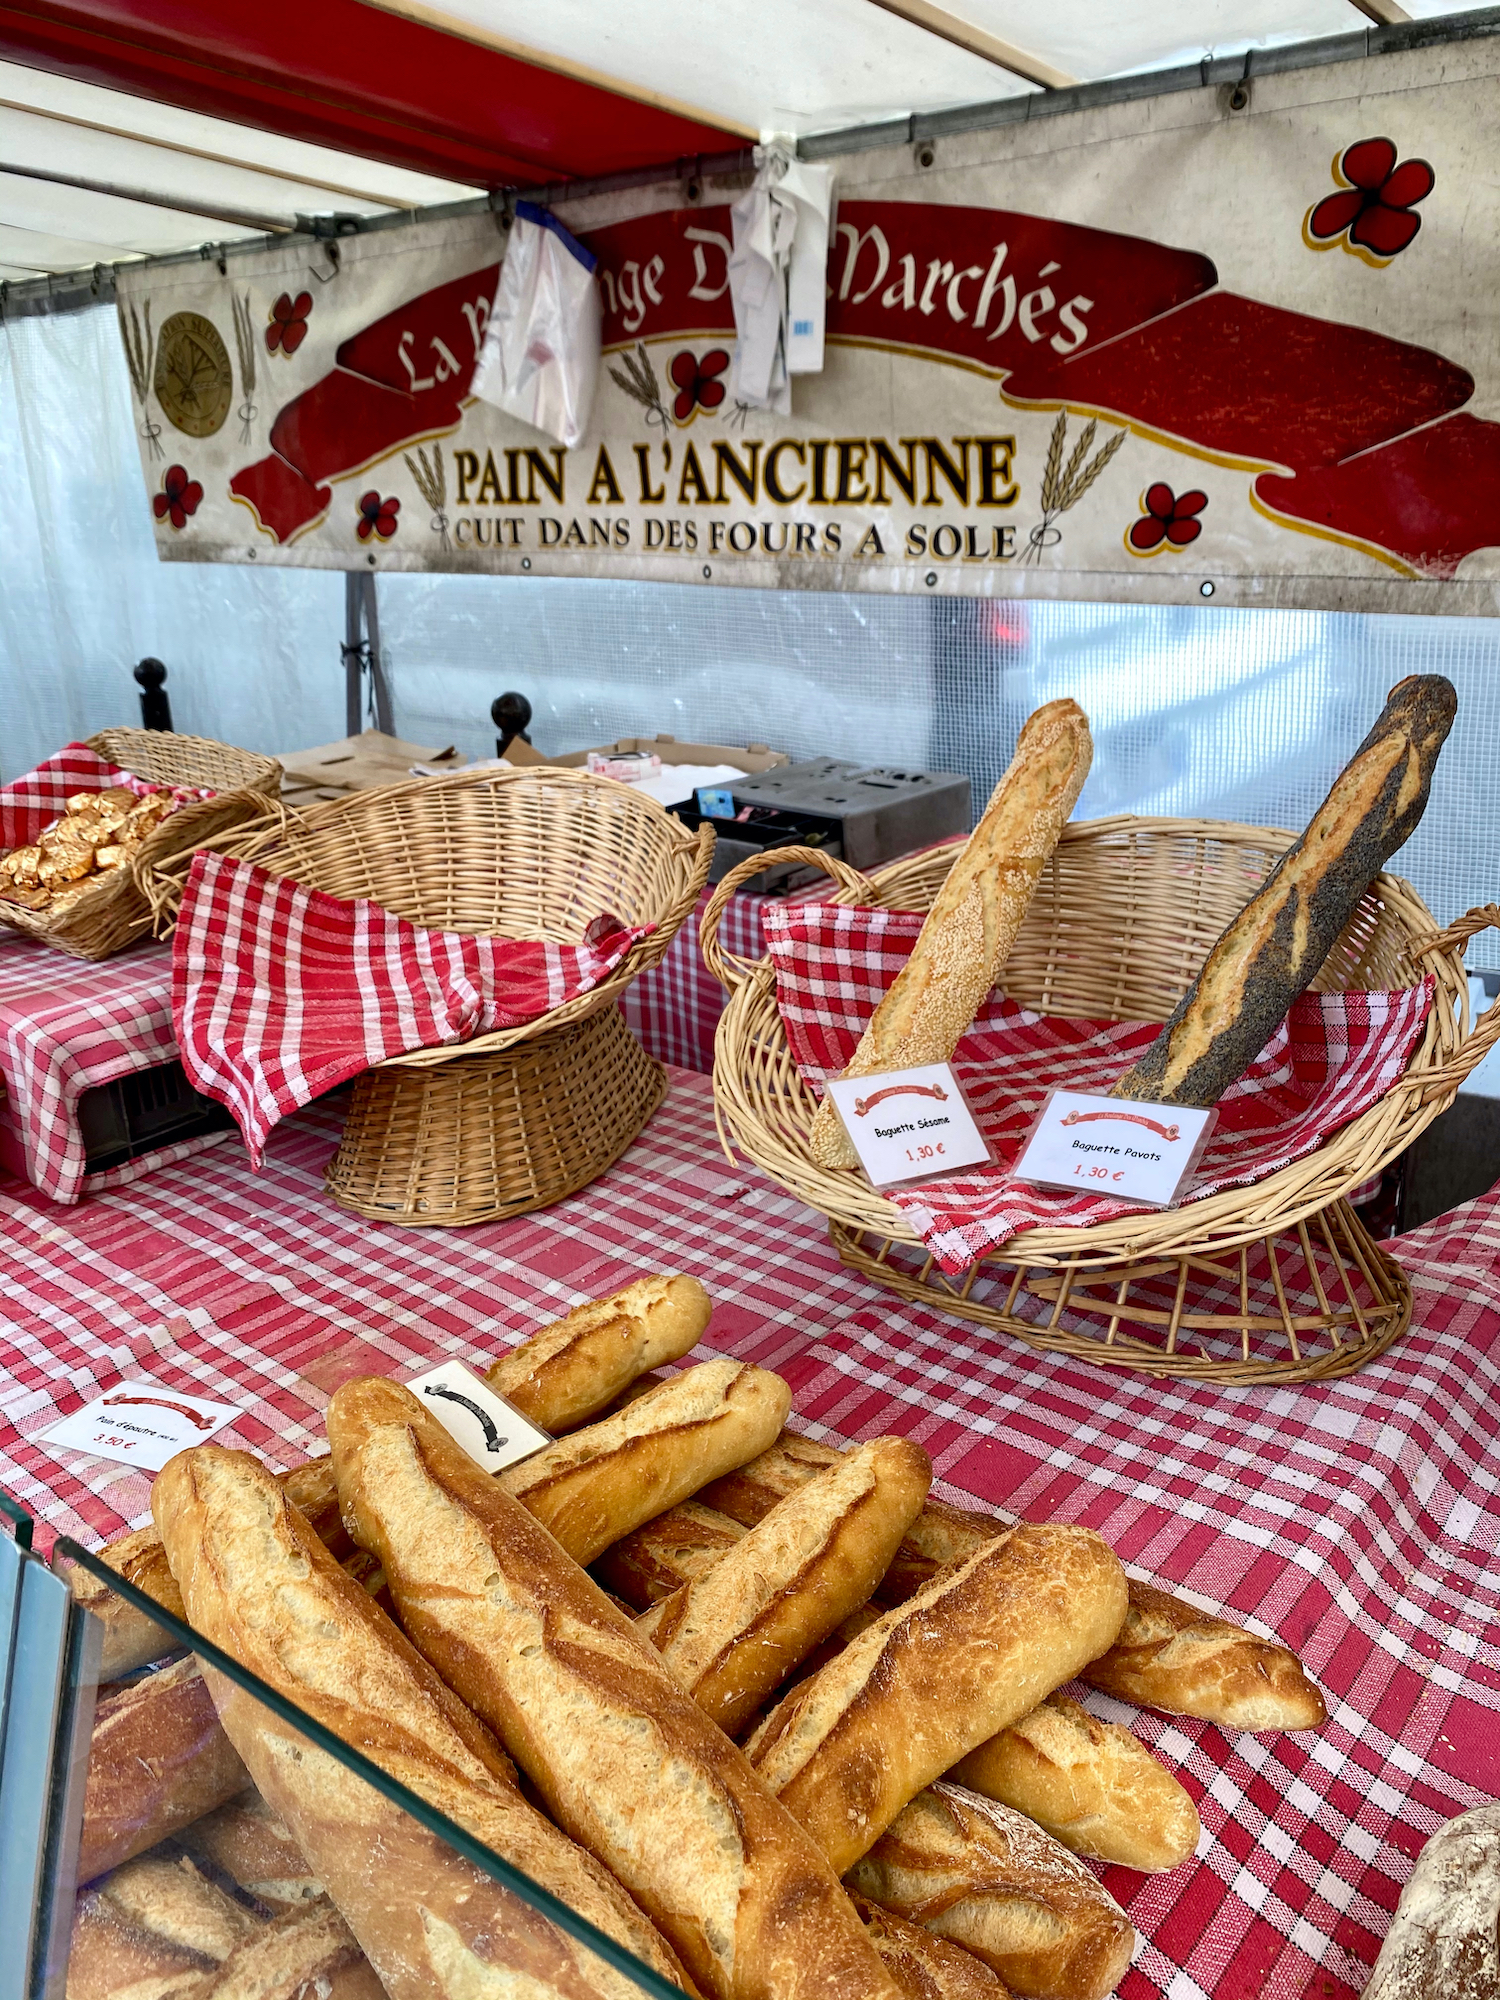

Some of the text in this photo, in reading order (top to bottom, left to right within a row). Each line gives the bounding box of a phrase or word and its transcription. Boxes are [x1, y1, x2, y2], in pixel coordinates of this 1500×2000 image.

[398, 330, 462, 393] La
[454, 434, 1020, 507] PAIN A L'ANCIENNE
[455, 517, 1018, 563] CUIT DANS DES FOURS A SOLE
[874, 1116, 951, 1138] Baguette Sésame
[905, 1142, 946, 1162] 1,30 €
[1071, 1139, 1162, 1161] Baguette Pavots
[1073, 1164, 1125, 1181] 1,30 €
[96, 1415, 115, 1426] Pain
[93, 1433, 137, 1449] 3,50 €
